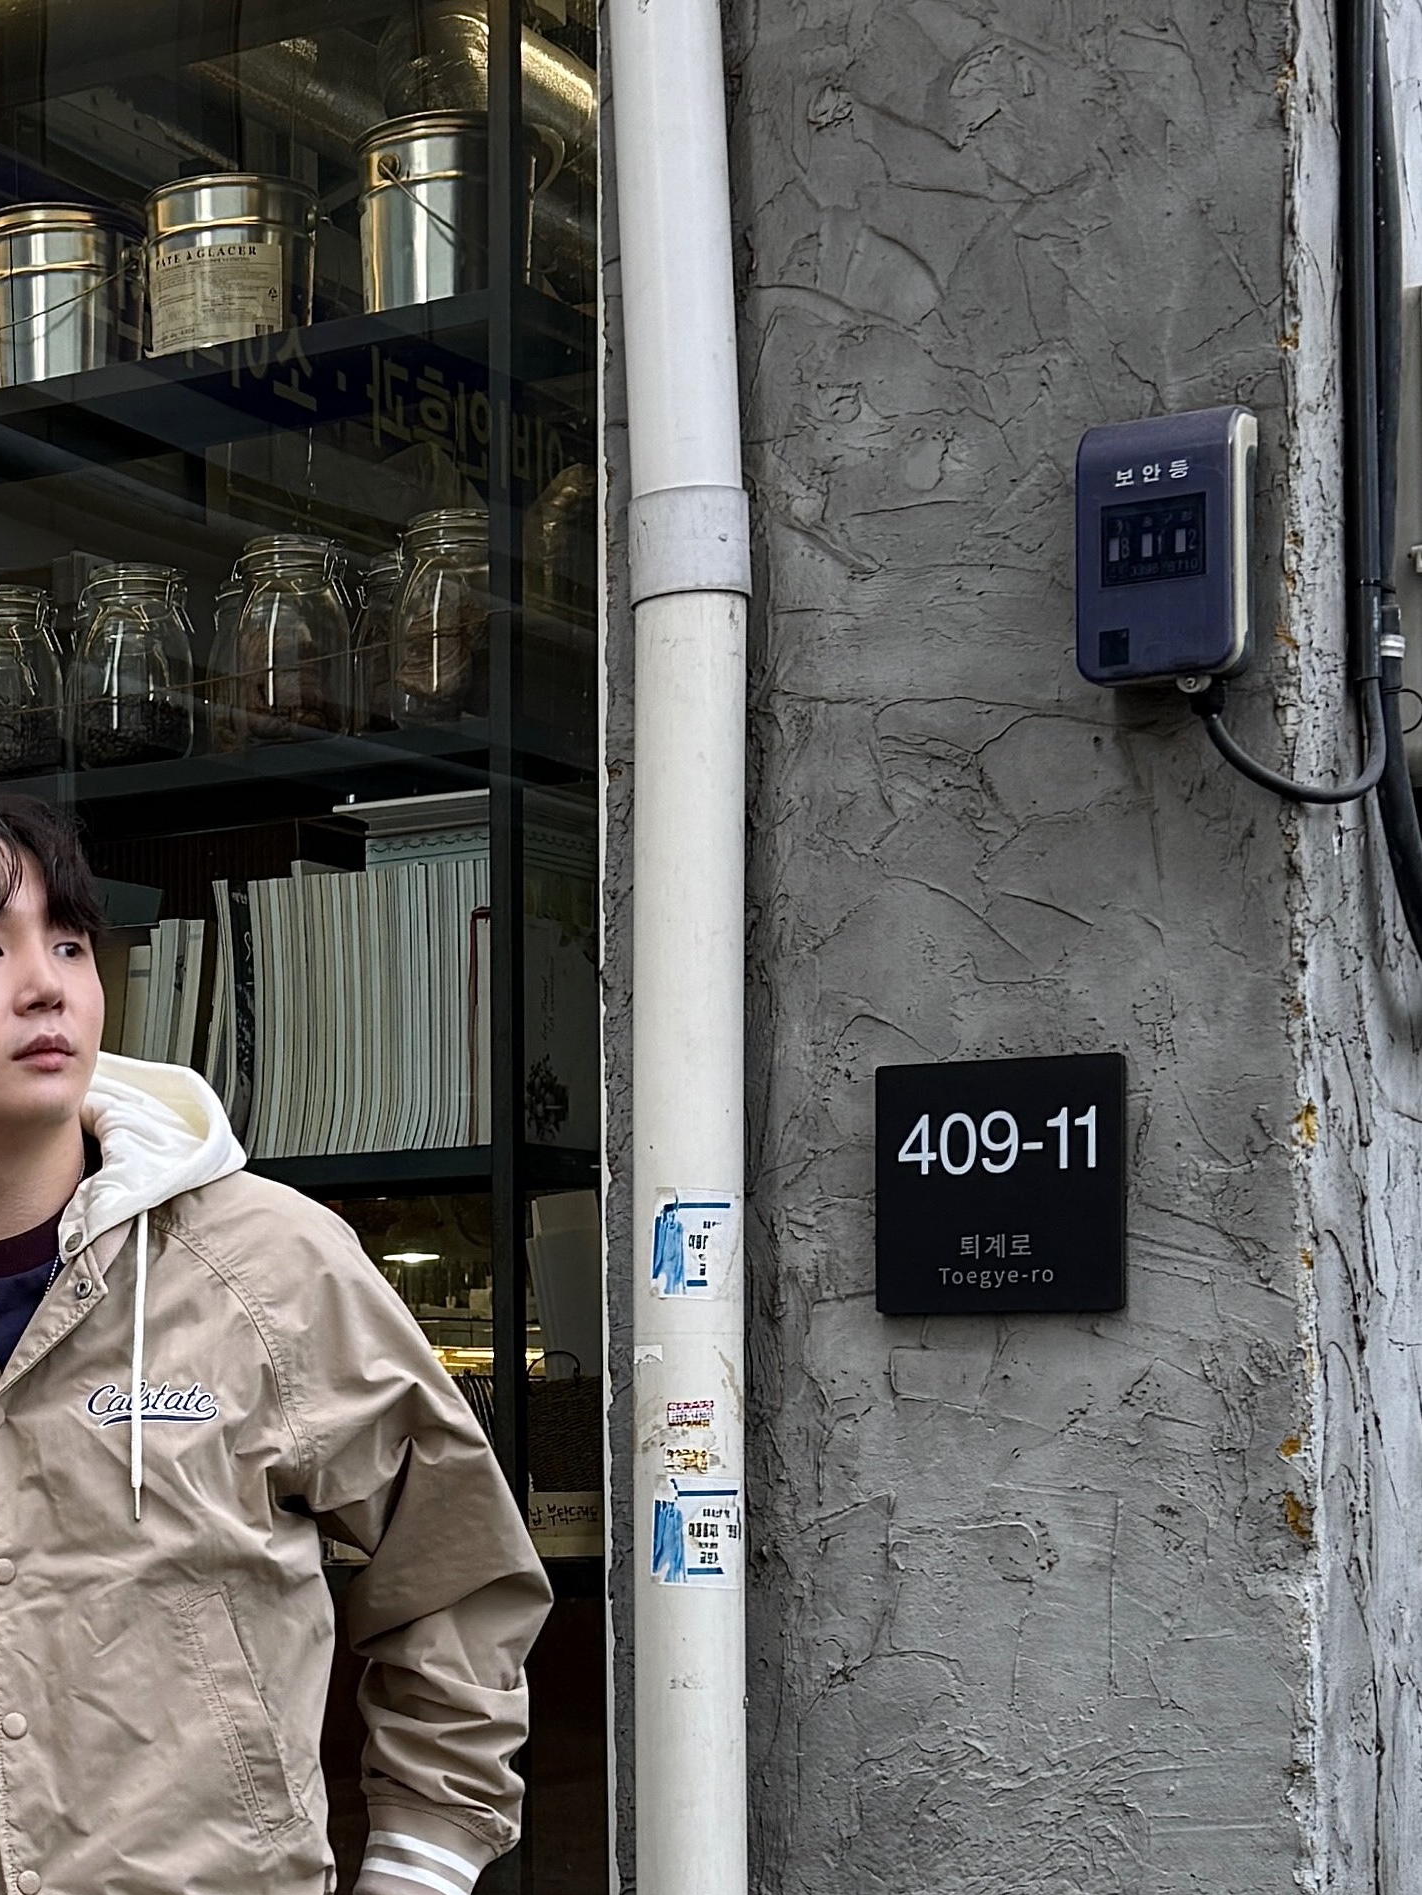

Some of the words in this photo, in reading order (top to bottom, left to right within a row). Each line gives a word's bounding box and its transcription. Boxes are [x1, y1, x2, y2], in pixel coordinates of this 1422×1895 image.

[196, 246, 257, 259] GLACER
[897, 1105, 1097, 1176] 409-11
[959, 1233, 1032, 1260] 퇴계로
[939, 1266, 1054, 1288] Toegye-ro
